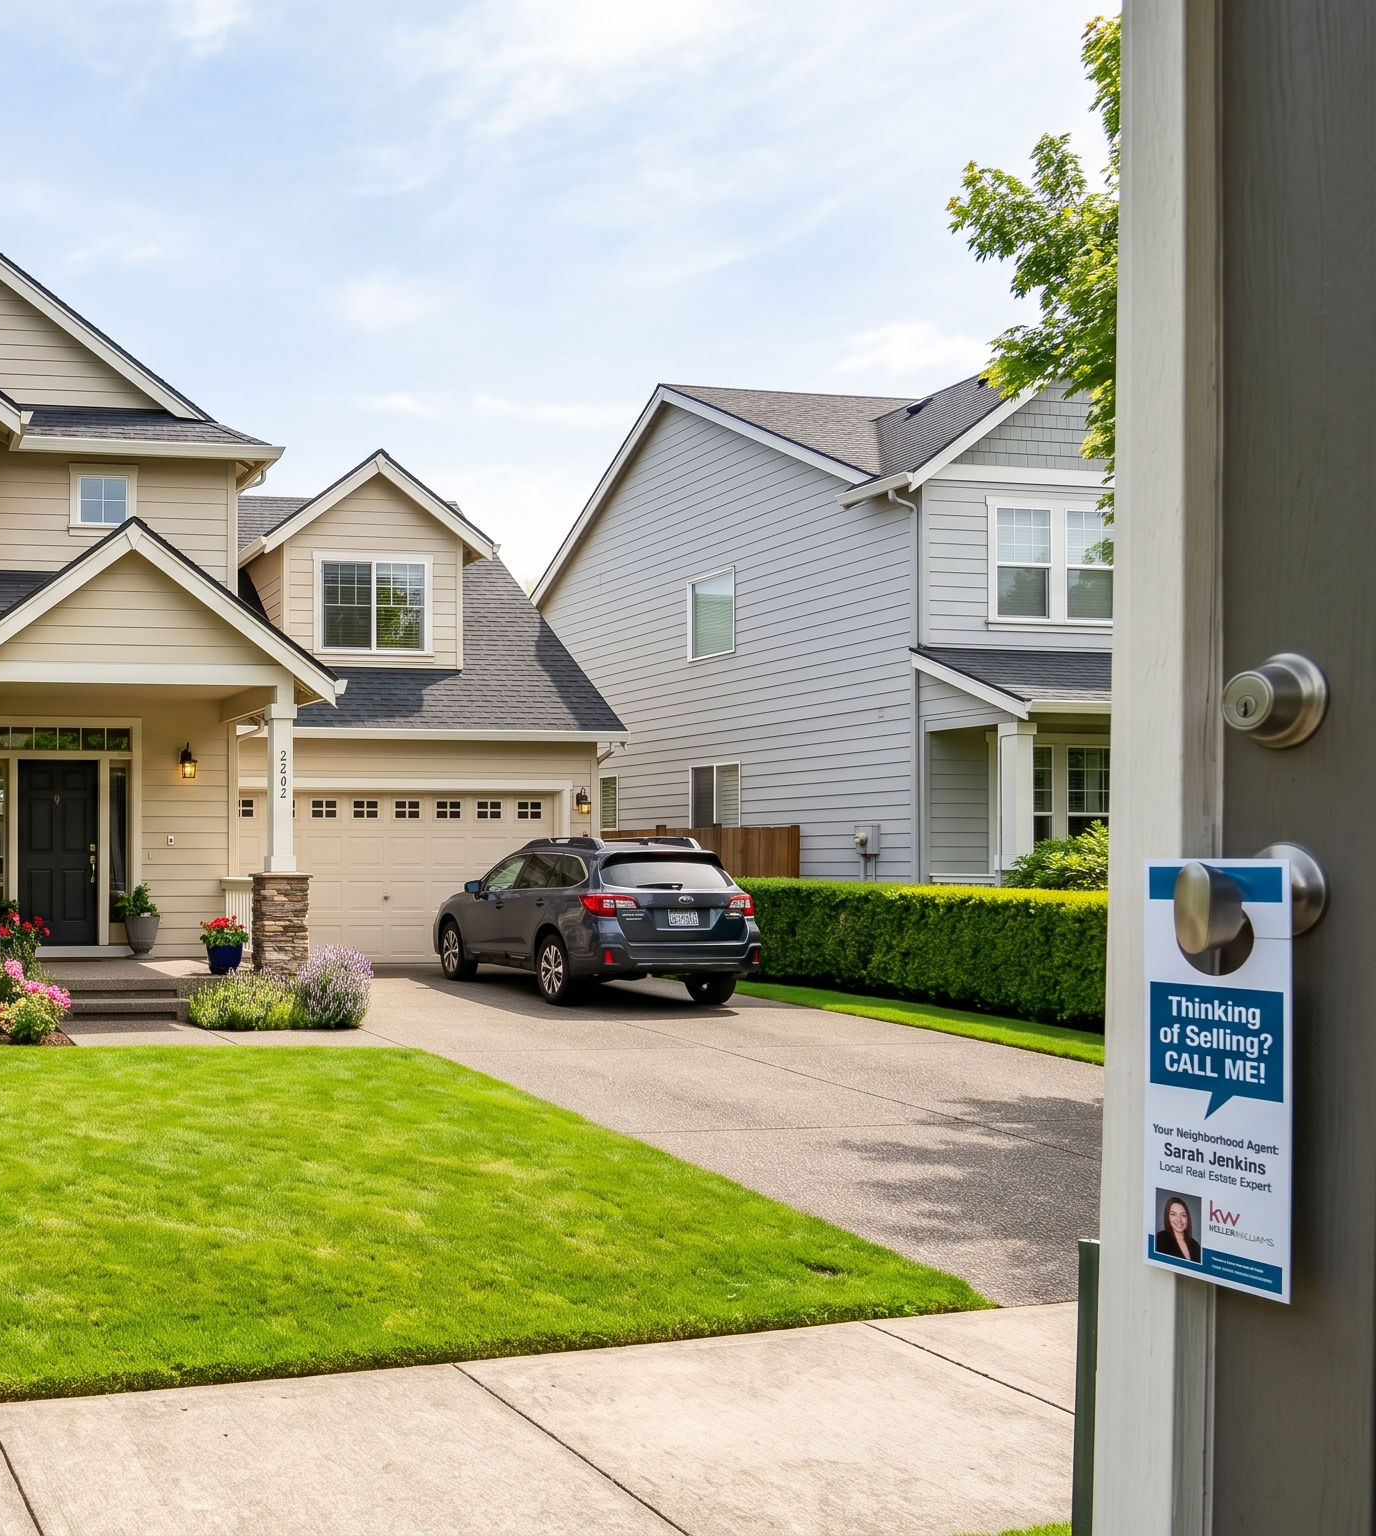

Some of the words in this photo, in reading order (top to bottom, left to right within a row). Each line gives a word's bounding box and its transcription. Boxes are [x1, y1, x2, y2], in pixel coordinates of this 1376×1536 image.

[1167, 995, 1261, 1030] Thinking
[1159, 1023, 1180, 1044] of
[1185, 1025, 1273, 1058] Selling?
[1165, 1050, 1218, 1078] CALL
[1224, 1058, 1266, 1084] ME!
[1153, 1123, 1174, 1136] Your
[1176, 1127, 1244, 1149] Neighborhood
[1246, 1140, 1279, 1156] Agent:
[1164, 1142, 1204, 1163] Sarah
[1209, 1151, 1266, 1175] Jenkins
[1159, 1160, 1183, 1174] Local
[1240, 1177, 1272, 1193] Expert
[1209, 1199, 1241, 1227] kw
